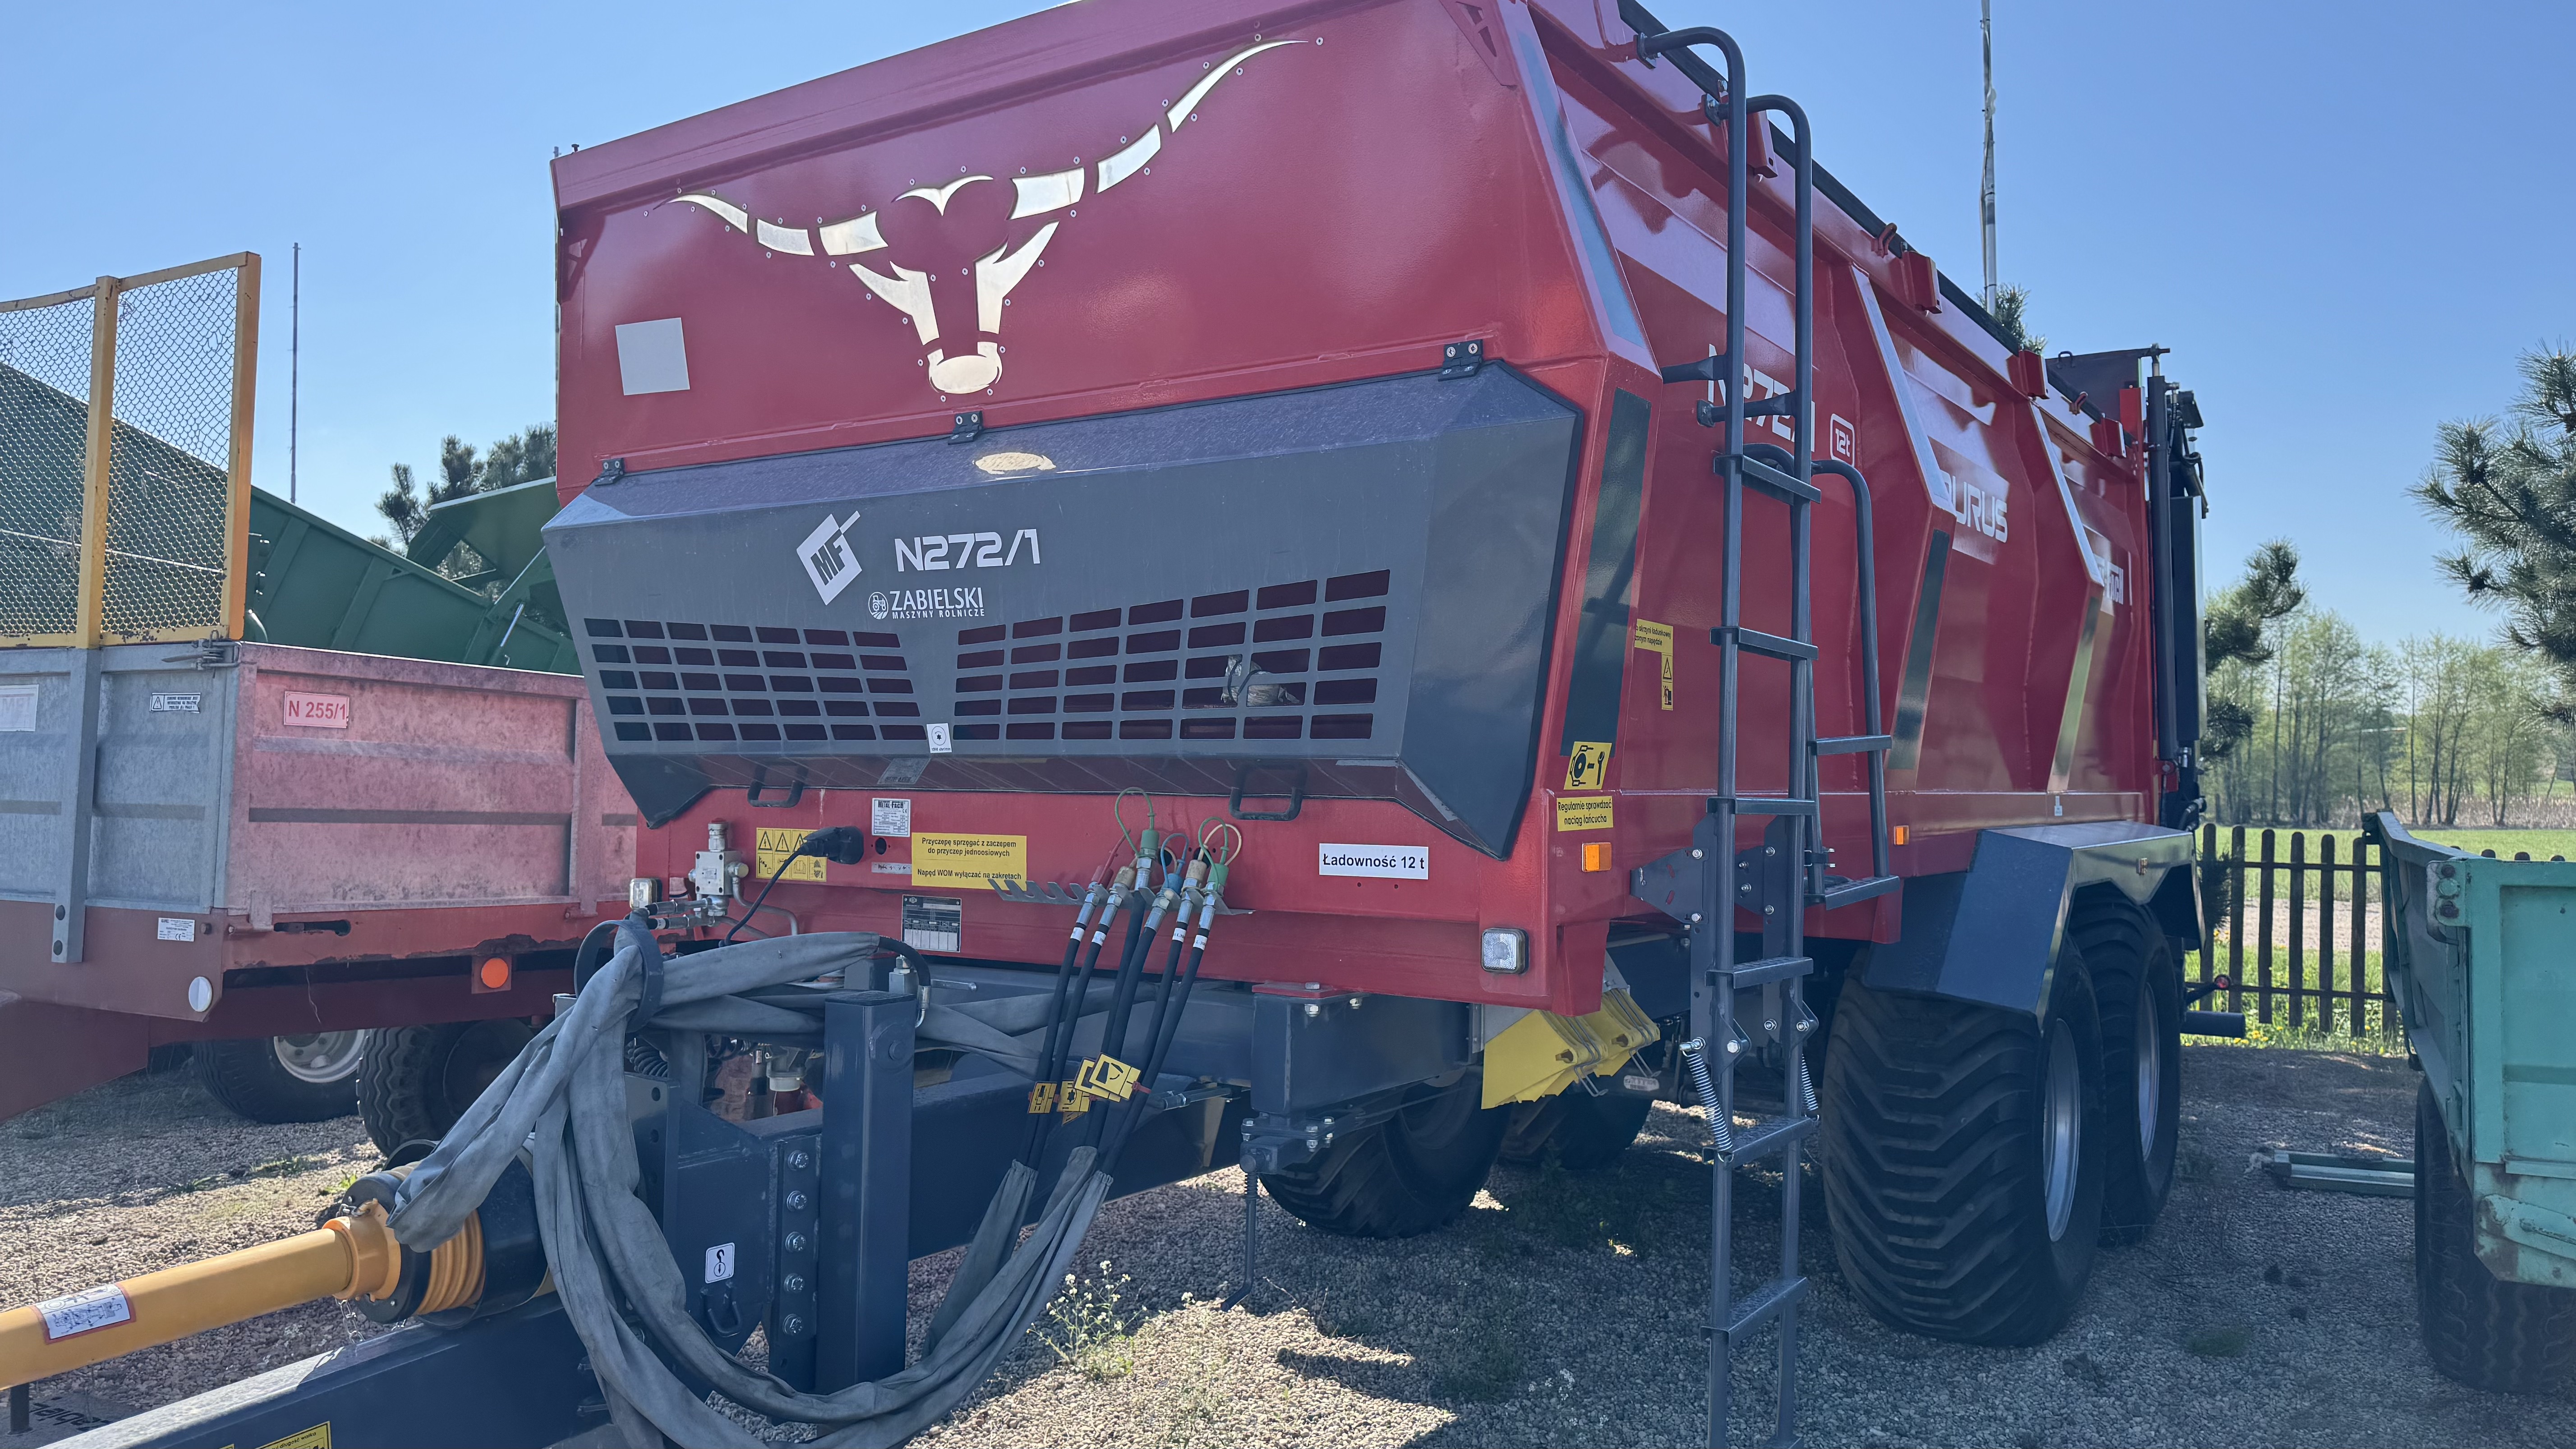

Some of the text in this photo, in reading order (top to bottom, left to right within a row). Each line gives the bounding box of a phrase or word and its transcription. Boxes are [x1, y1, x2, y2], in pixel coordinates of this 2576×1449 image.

[894, 529, 1040, 572] N272/1
[889, 587, 984, 612] ZABIELSKI
[892, 608, 985, 619] MASZYNY ROLNICZE
[289, 700, 345, 720] N 255/1
[1558, 798, 1612, 813] Regularnie sprawdzać
[1564, 815, 1582, 826] naciąg
[922, 837, 951, 846] Przyczepę
[953, 839, 980, 847] sprzęgać
[964, 848, 1010, 857] jednoosiowych
[1323, 853, 1425, 869] Ładowność 12 t
[917, 869, 936, 877] Napęd
[954, 871, 981, 879] wyłączać
